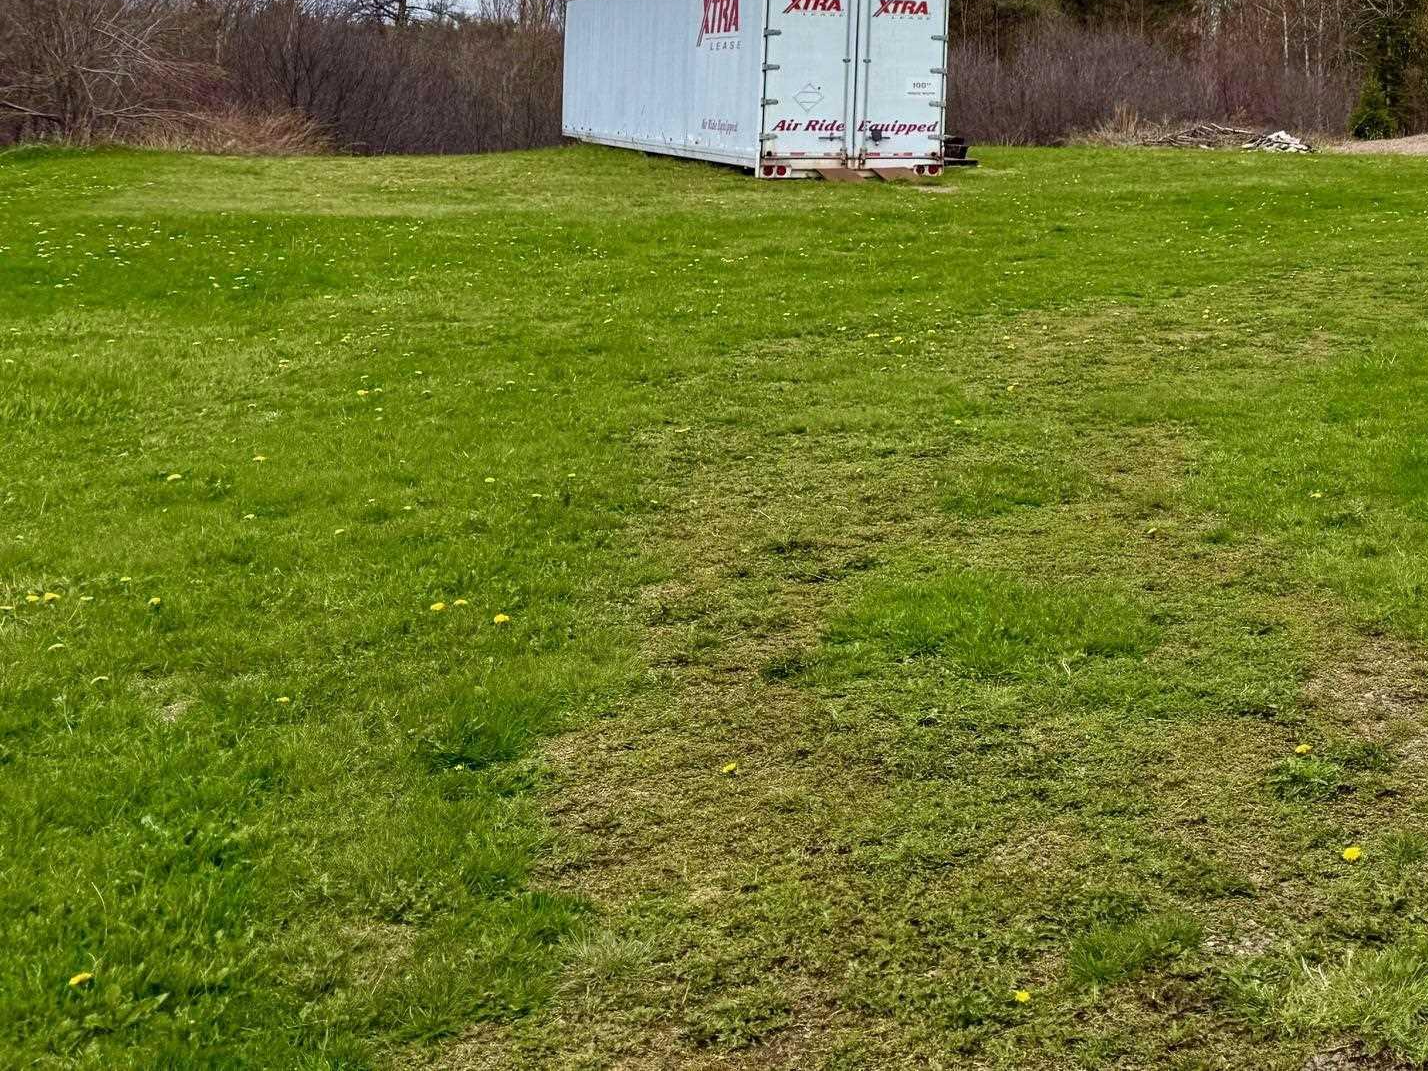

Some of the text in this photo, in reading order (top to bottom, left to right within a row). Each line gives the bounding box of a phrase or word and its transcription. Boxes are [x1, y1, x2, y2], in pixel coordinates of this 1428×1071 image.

[710, 40, 743, 50] LEASE
[772, 119, 939, 135] Air Ride Equipped
